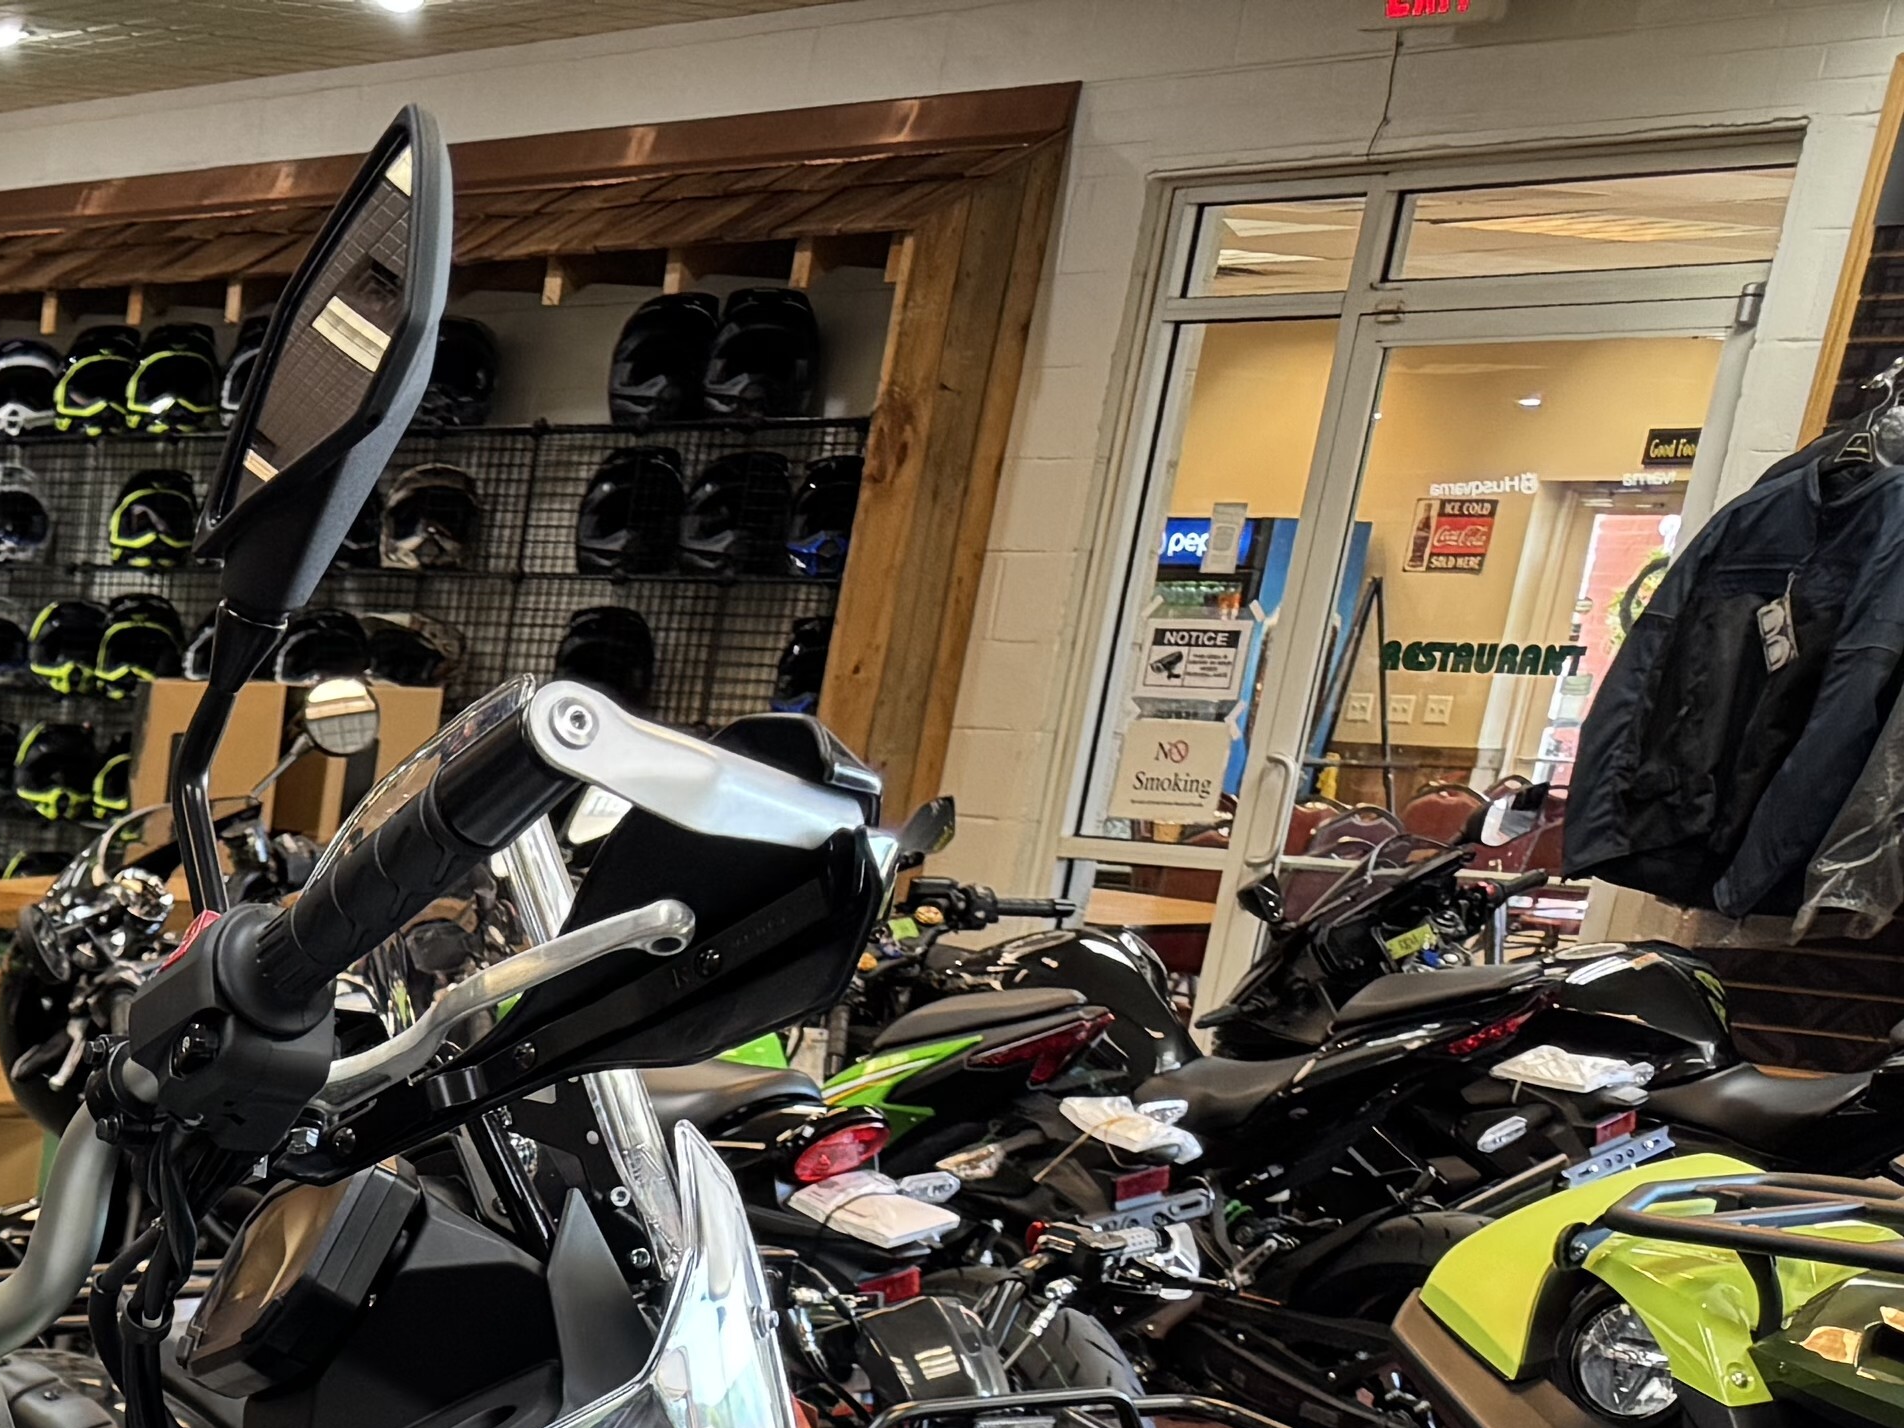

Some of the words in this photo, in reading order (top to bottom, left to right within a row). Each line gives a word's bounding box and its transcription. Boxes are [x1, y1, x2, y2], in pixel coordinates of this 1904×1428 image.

[1677, 438, 1697, 457] Foo
[1444, 501, 1460, 515] ICE
[1462, 501, 1492, 516] COLD
[1167, 532, 1210, 557] pep
[1430, 556, 1455, 569] SOLD
[1456, 556, 1483, 569] HERE
[1163, 630, 1229, 647] NOTICE
[1381, 640, 1588, 677] RESTAURANT
[1132, 769, 1212, 798] Smoking
